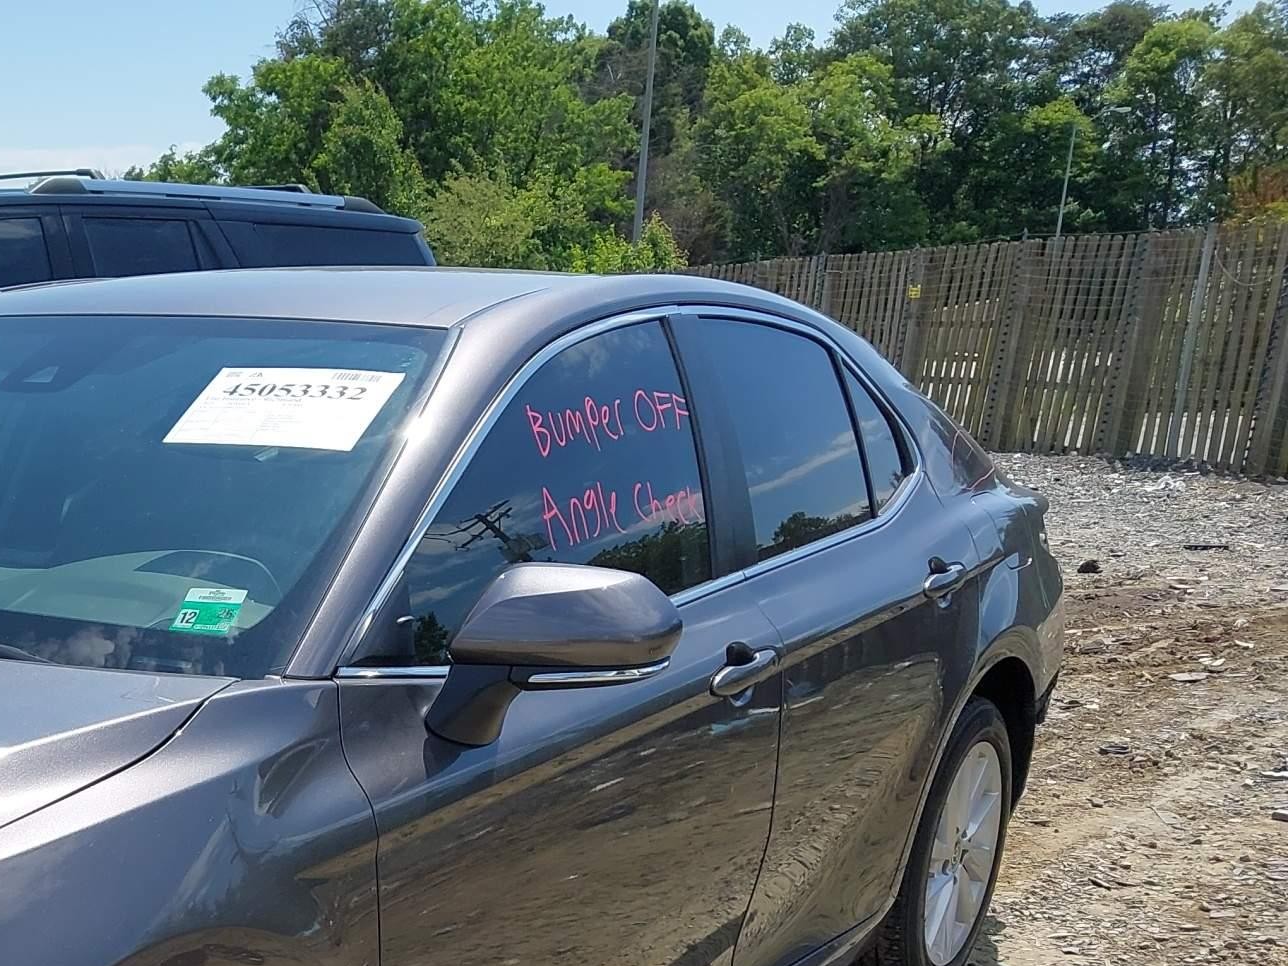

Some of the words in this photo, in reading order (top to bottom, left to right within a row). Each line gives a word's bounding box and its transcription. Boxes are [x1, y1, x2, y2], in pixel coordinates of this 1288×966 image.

[222, 383, 368, 400] 45053332
[526, 396, 624, 457] Bumper
[633, 389, 689, 431] OFF
[541, 481, 628, 551] Angle
[632, 481, 705, 526] Check
[179, 611, 197, 624] 12
